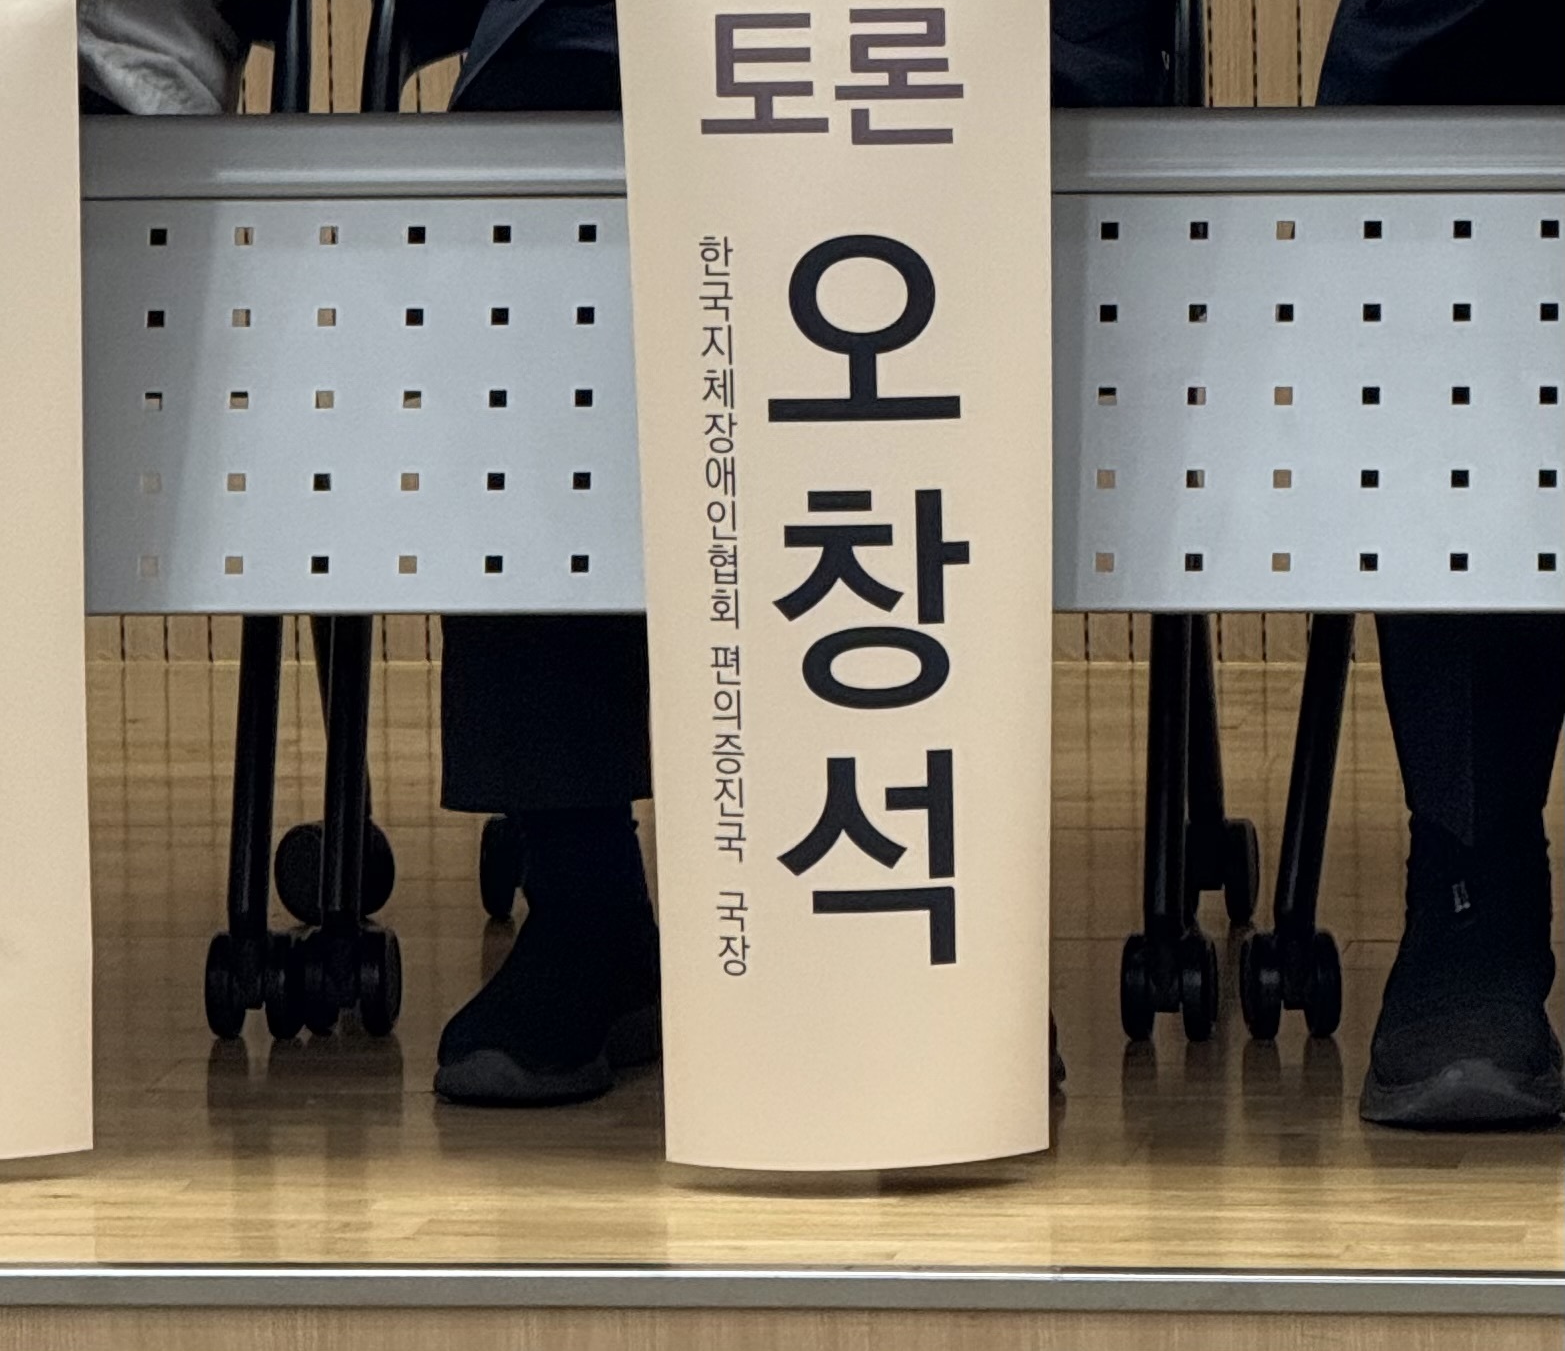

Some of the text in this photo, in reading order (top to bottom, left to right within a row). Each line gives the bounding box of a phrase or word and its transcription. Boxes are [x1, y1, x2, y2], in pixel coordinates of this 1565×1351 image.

[701, 8, 964, 146] 토론
[699, 235, 751, 977] 한국지체장애인협회 편의증진국 국장
[768, 234, 970, 966] 오창석
